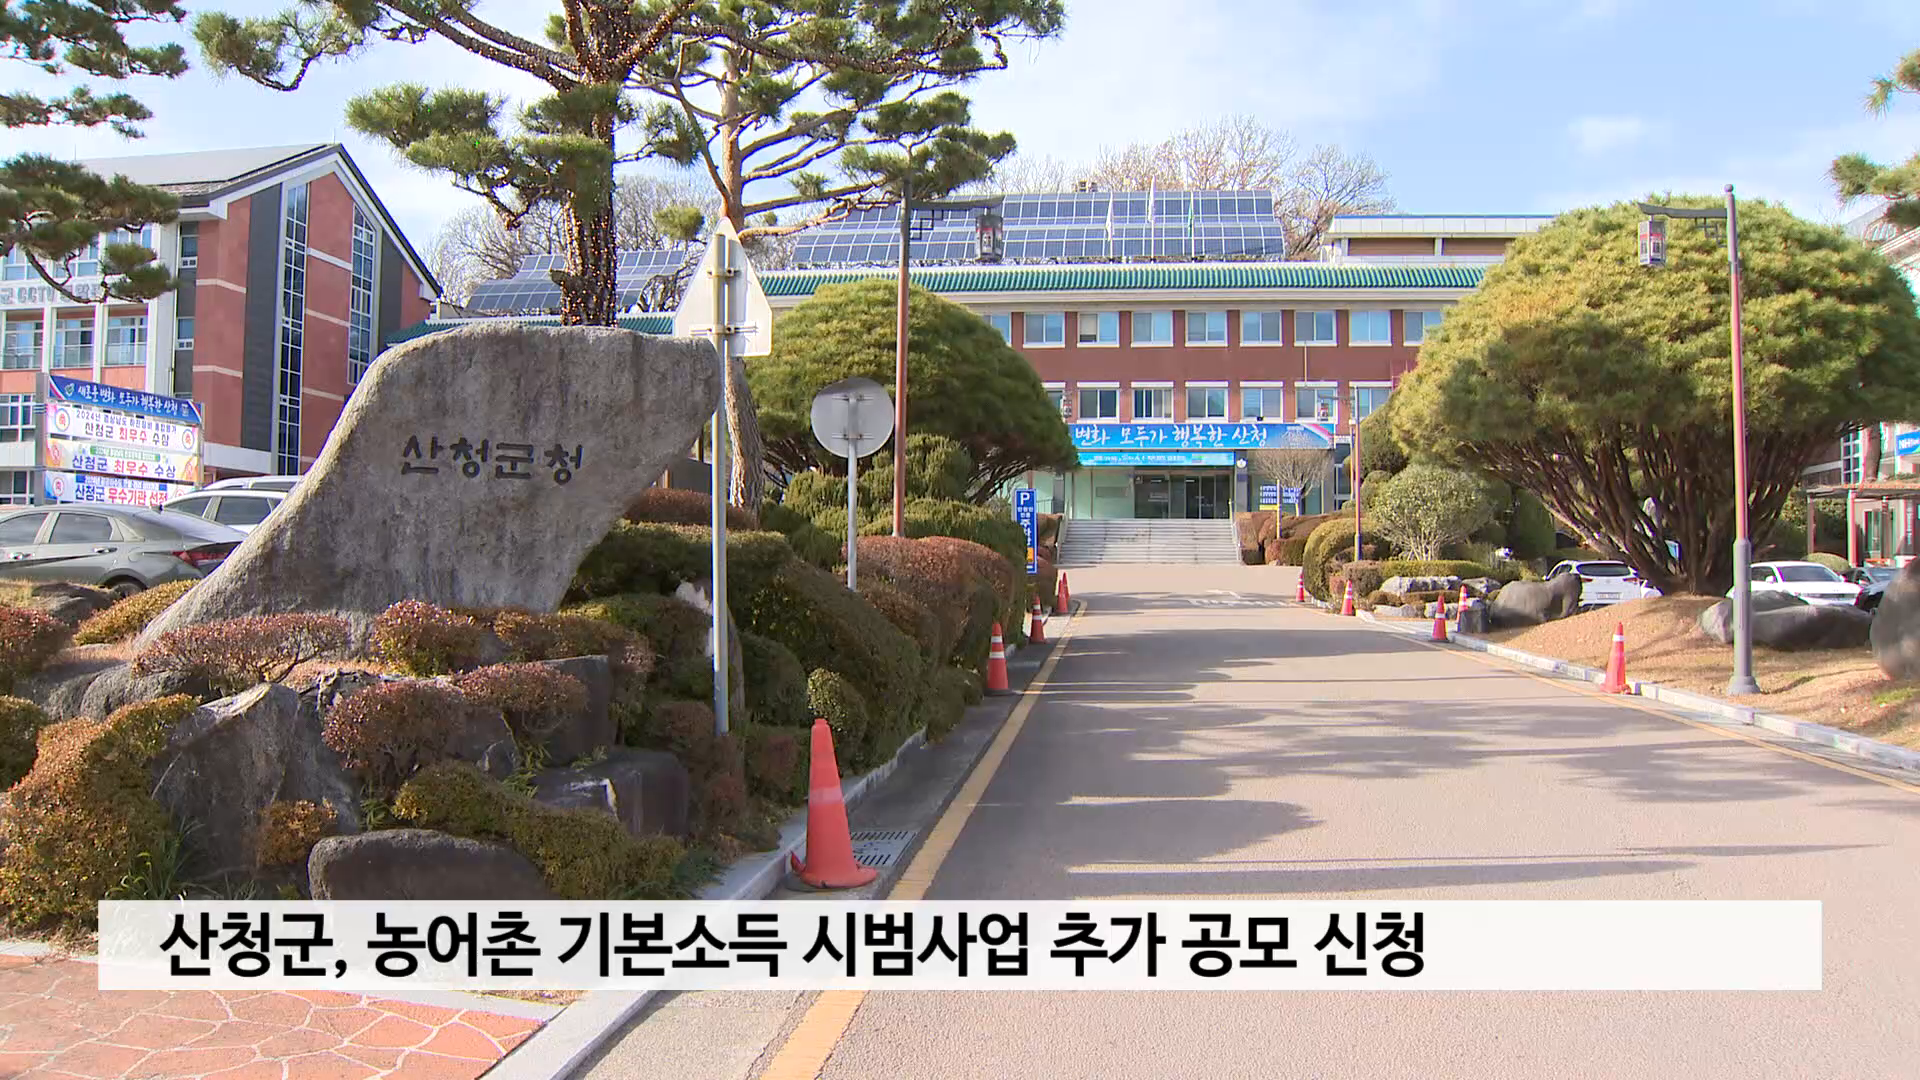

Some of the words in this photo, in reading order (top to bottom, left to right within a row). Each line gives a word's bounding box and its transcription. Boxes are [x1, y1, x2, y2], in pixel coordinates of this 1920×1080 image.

[18, 285, 55, 304] CCTV
[78, 384, 99, 402] 새로운
[100, 387, 116, 403] 변화
[119, 392, 139, 406] 모두가
[141, 393, 162, 412] 행복한
[164, 399, 178, 415] 산청
[76, 409, 101, 422] 2024년
[85, 422, 114, 439] 산청군
[119, 427, 147, 443] 최우수
[152, 432, 170, 447] 수상
[1075, 425, 1110, 446] 변화
[1120, 427, 1167, 447] 모두가
[1172, 425, 1227, 448] 행복한
[1232, 427, 1268, 448] 산청
[72, 455, 108, 472] 산청군
[113, 459, 148, 476] 최우수
[154, 464, 176, 479] 수상
[401, 434, 583, 486] 산청군청
[75, 484, 105, 503] 산청군
[108, 487, 146, 506] 우수기관
[1020, 492, 1031, 506] P
